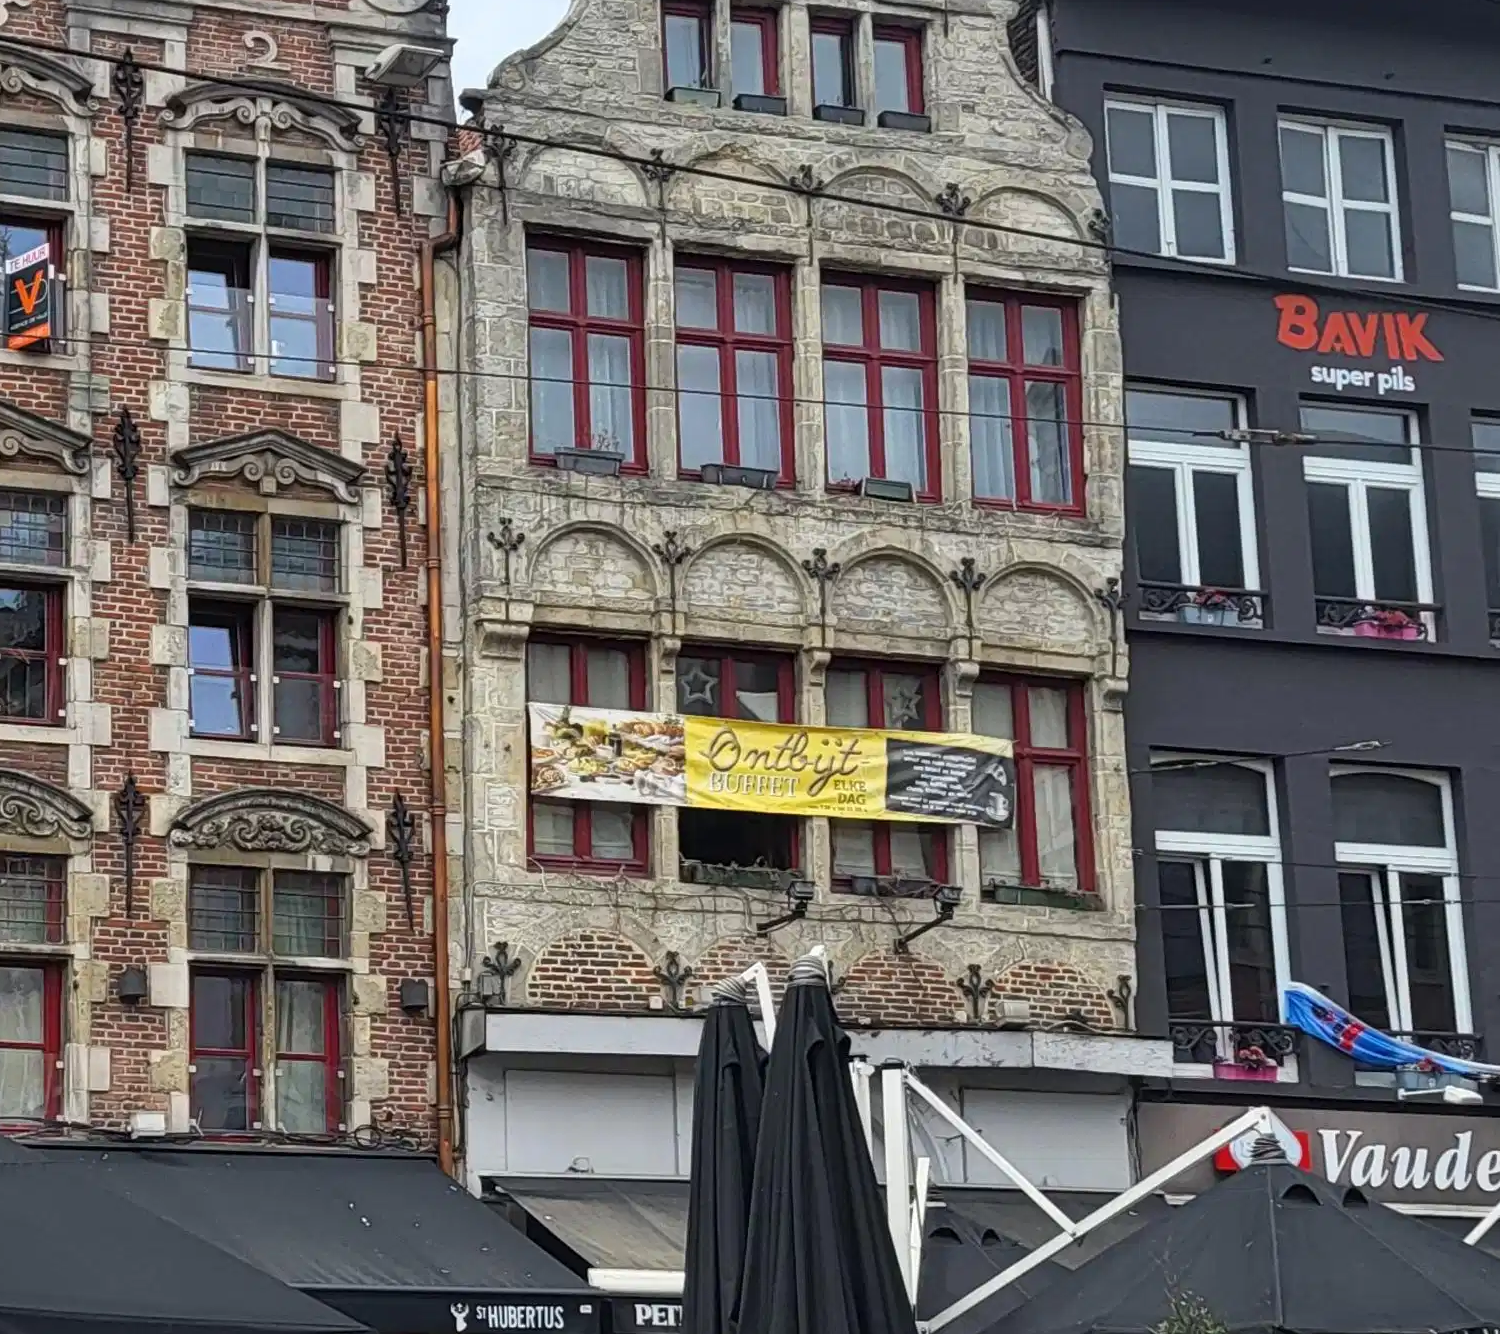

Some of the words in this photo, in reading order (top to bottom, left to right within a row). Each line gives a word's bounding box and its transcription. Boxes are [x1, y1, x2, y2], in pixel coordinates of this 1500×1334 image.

[242, 30, 292, 70] 2
[22, 247, 46, 266] HUUR
[1272, 293, 1445, 362] BAVIK
[1311, 365, 1375, 391] super
[1377, 365, 1416, 395] pils
[709, 771, 800, 798] BUFFET
[833, 779, 867, 793] ELKE
[837, 793, 867, 805] DAG
[488, 1305, 565, 1329] HUBERTUS
